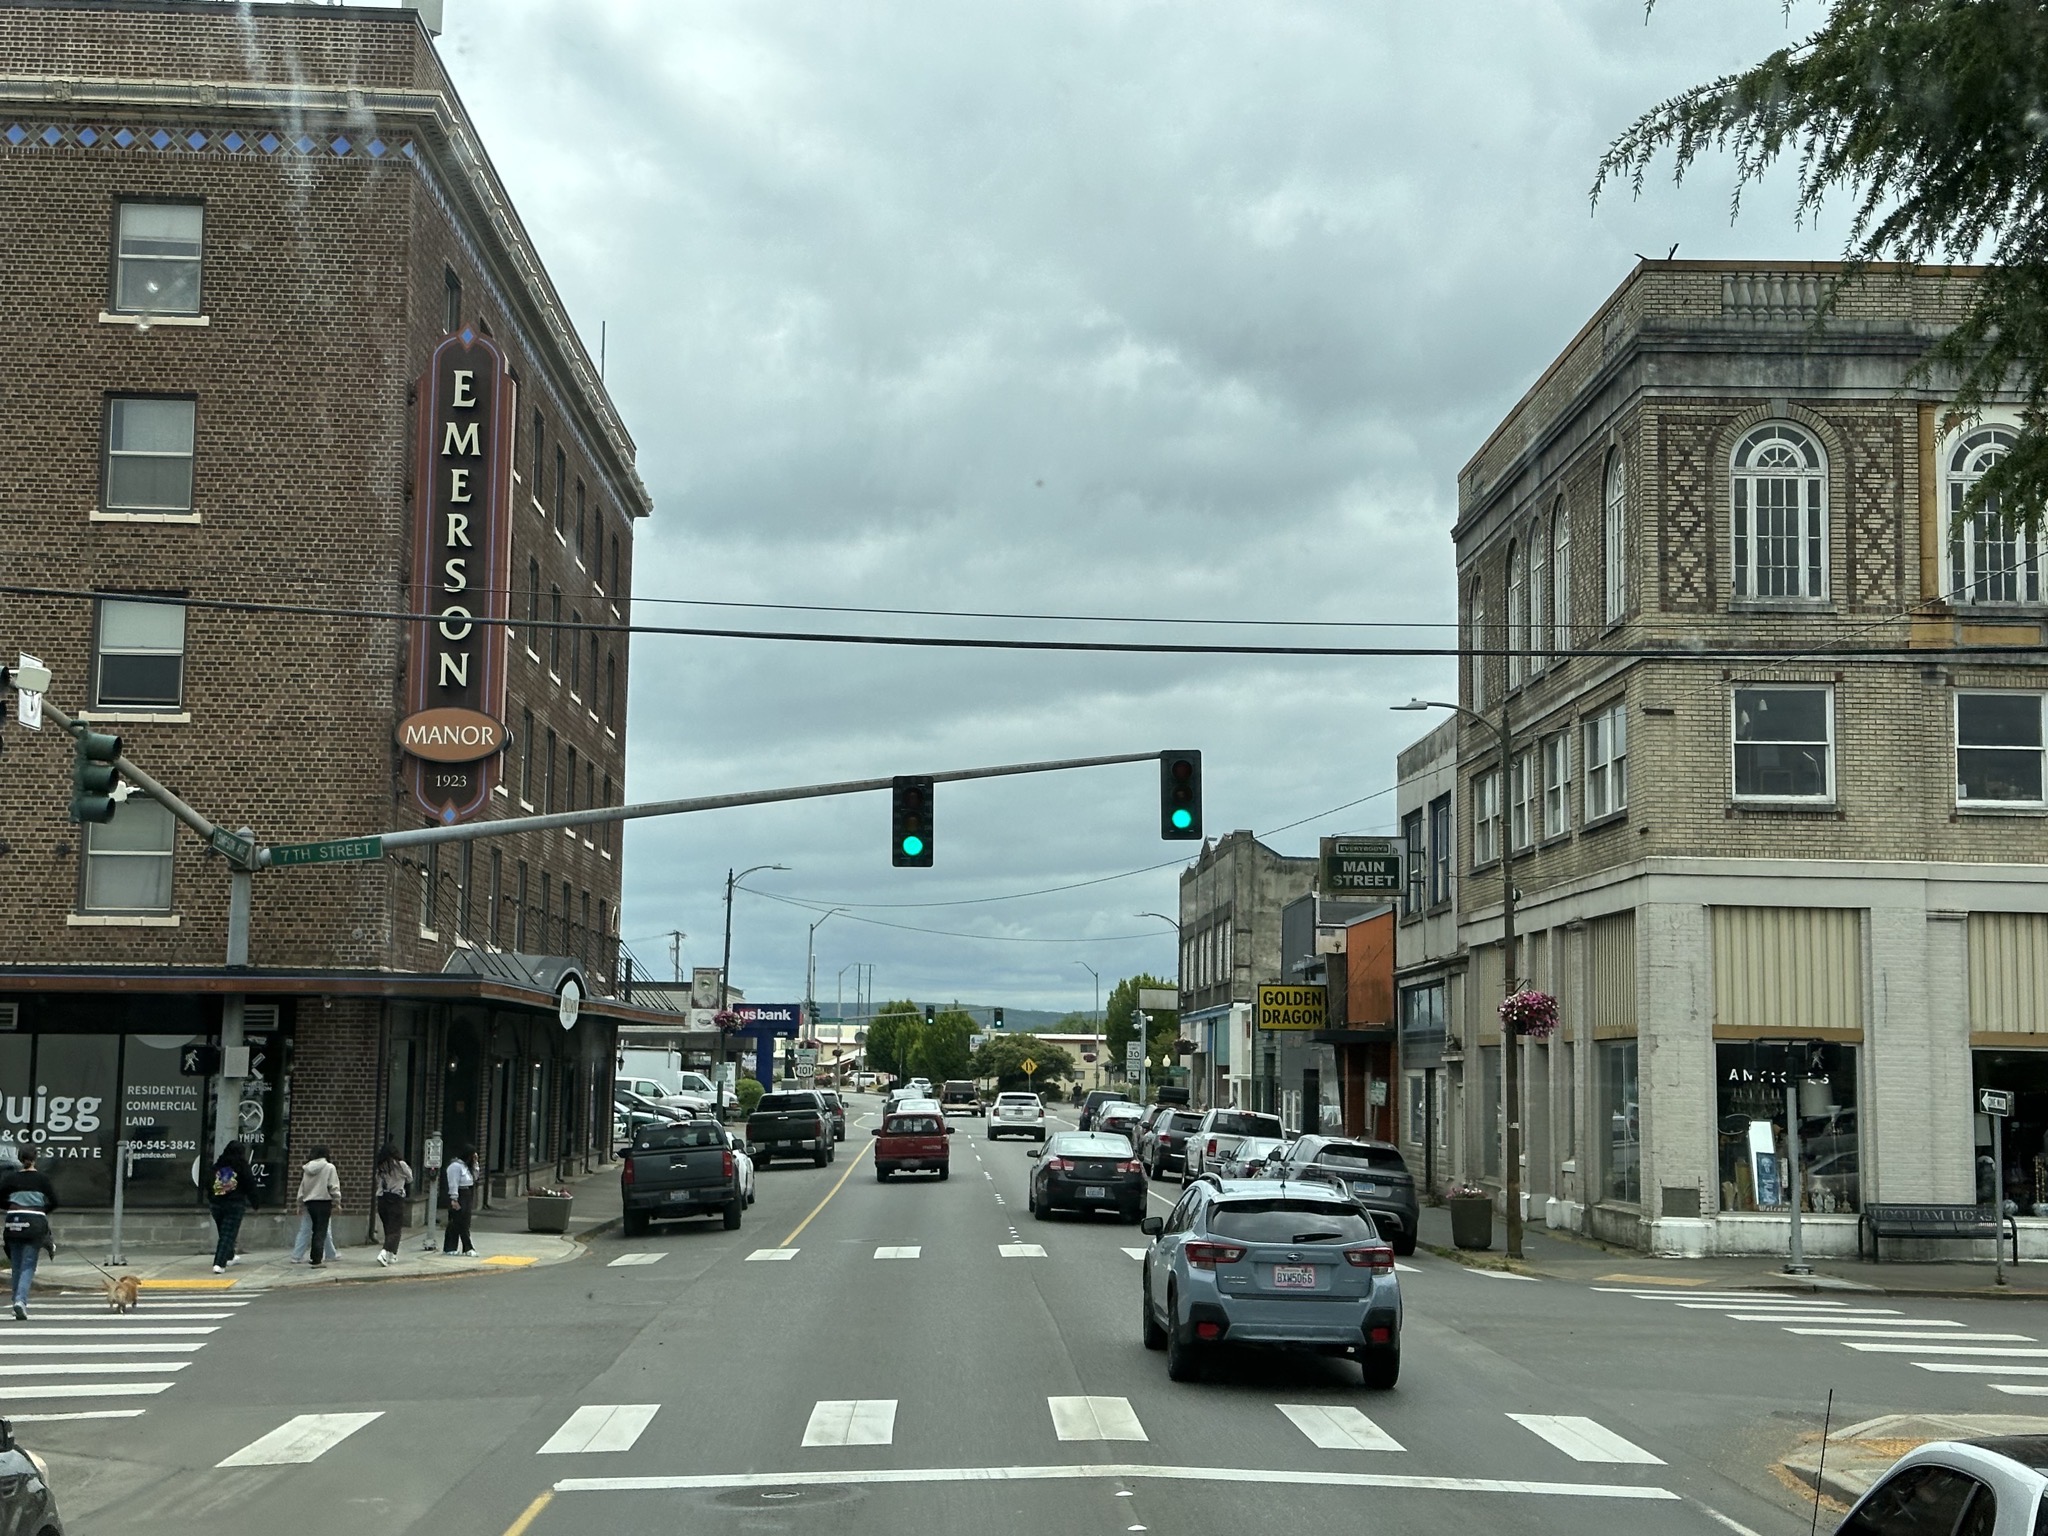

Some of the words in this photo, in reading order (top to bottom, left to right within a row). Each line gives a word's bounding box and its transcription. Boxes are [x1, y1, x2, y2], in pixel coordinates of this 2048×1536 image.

[438, 370, 481, 687] EMERSON
[405, 725, 495, 745] MANOR
[435, 775, 467, 787] 1923
[280, 849, 311, 861] 7TH
[319, 842, 371, 858] STREET
[1343, 861, 1385, 873] MAIN
[1333, 874, 1395, 887] STREET
[1263, 991, 1322, 1006] GOLDEN
[1262, 1009, 1323, 1024] DRAGON
[799, 1066, 812, 1075] 101
[127, 1085, 198, 1096] RESIDENTIAL
[126, 1101, 198, 1111] COMMERCIAL
[125, 1116, 155, 1126] LAND
